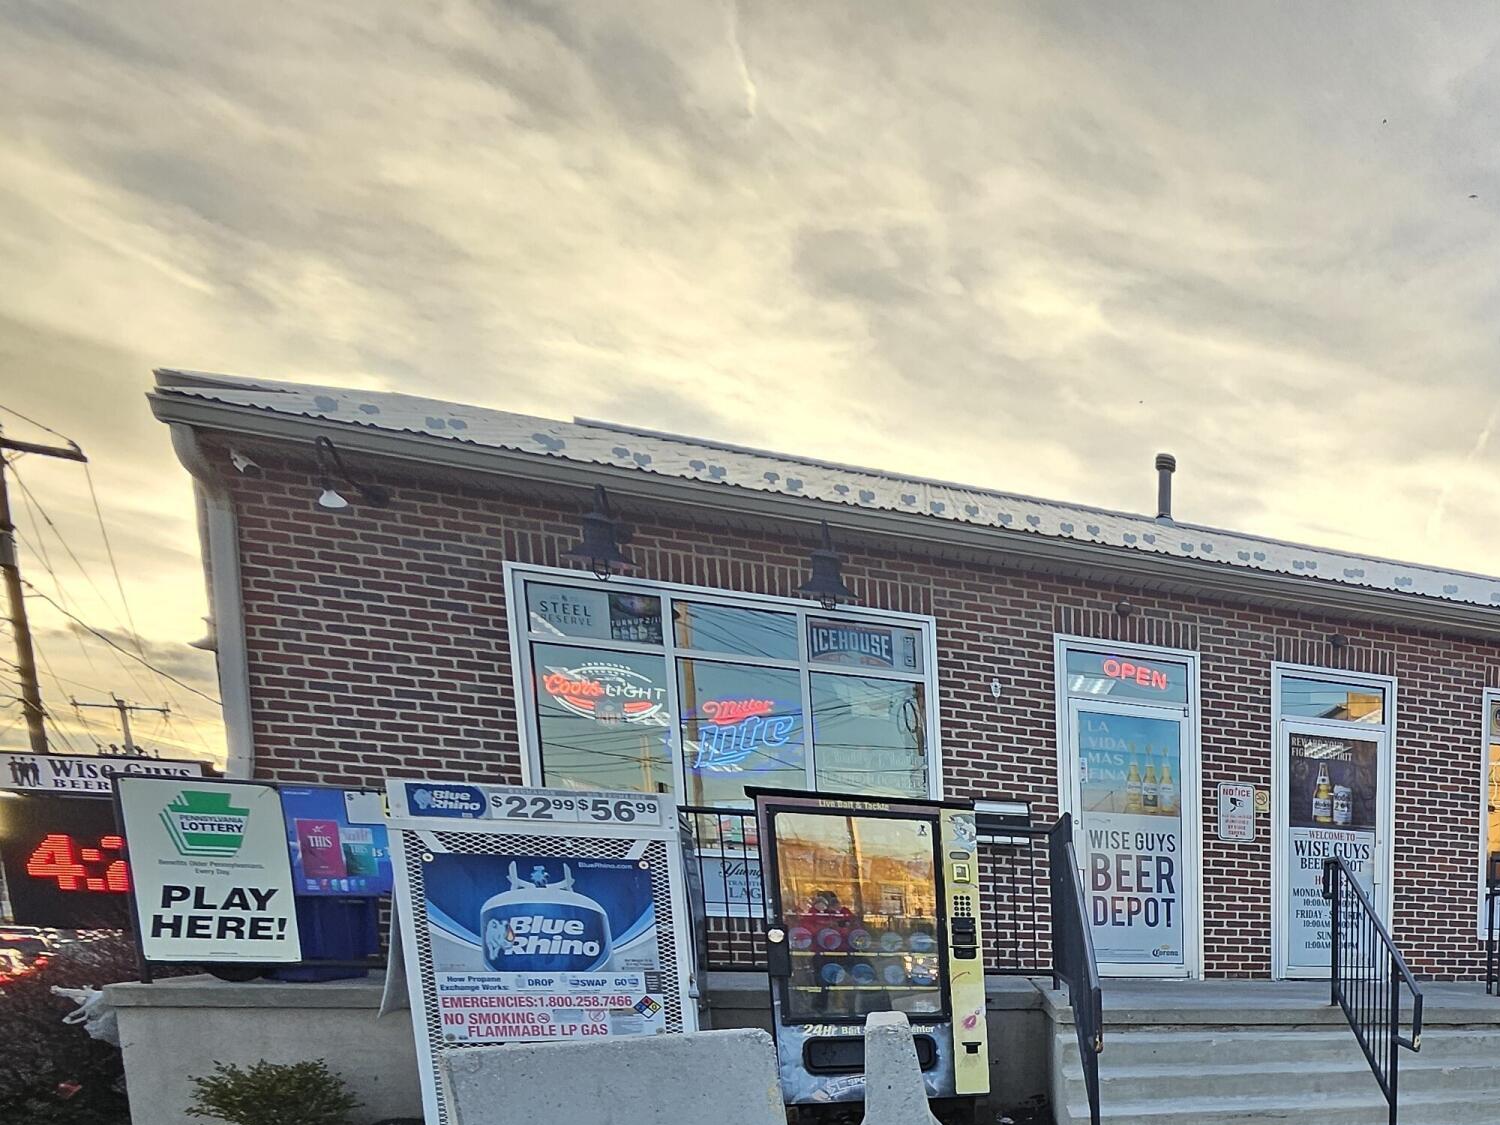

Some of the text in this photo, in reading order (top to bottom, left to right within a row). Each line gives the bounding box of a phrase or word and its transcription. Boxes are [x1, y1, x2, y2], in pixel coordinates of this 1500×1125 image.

[540, 600, 592, 617] STEEL
[812, 627, 892, 660] ICEHOUSE
[1103, 659, 1168, 690] OPEN
[605, 683, 667, 700] LIGHT
[702, 699, 775, 725] Miller
[1087, 720, 1109, 733] LA
[694, 716, 794, 769] Lite
[1088, 737, 1128, 752] VIDA
[47, 758, 113, 780] Wise
[53, 778, 111, 790] BEER
[431, 790, 471, 801] Blue
[1222, 788, 1251, 798] NOTICE
[430, 799, 481, 811] Rhino
[818, 800, 836, 808] Live
[837, 801, 853, 809] Bait
[864, 802, 890, 811] Tackle
[179, 814, 244, 824] PENNSYLVANIA
[180, 822, 244, 833] LOTTERY
[1089, 829, 1176, 852] WISE GUYS
[1308, 830, 1356, 842] WELCOME TO
[1294, 840, 1370, 860] WISE GUYS
[578, 861, 633, 870] BlueRhino.com
[1090, 852, 1176, 894] BEER
[161, 885, 279, 912] PLAY
[1092, 895, 1176, 928] DEPOT
[1295, 909, 1322, 919] FRIDAY
[151, 914, 287, 941] HERE!
[508, 916, 584, 935] Blue
[504, 936, 600, 957] Rhino
[1152, 948, 1179, 958] Corona
[467, 976, 502, 984] Propane
[527, 978, 554, 987] DROP
[579, 978, 607, 988] SWAP
[614, 978, 628, 987] GO
[440, 983, 480, 993] Exchange
[443, 1012, 536, 1026] NO SMOKING
[467, 1023, 609, 1039] FLAMMABLE LP GAS
[803, 1024, 838, 1037] 24Hr
[841, 1026, 861, 1035] Bait
